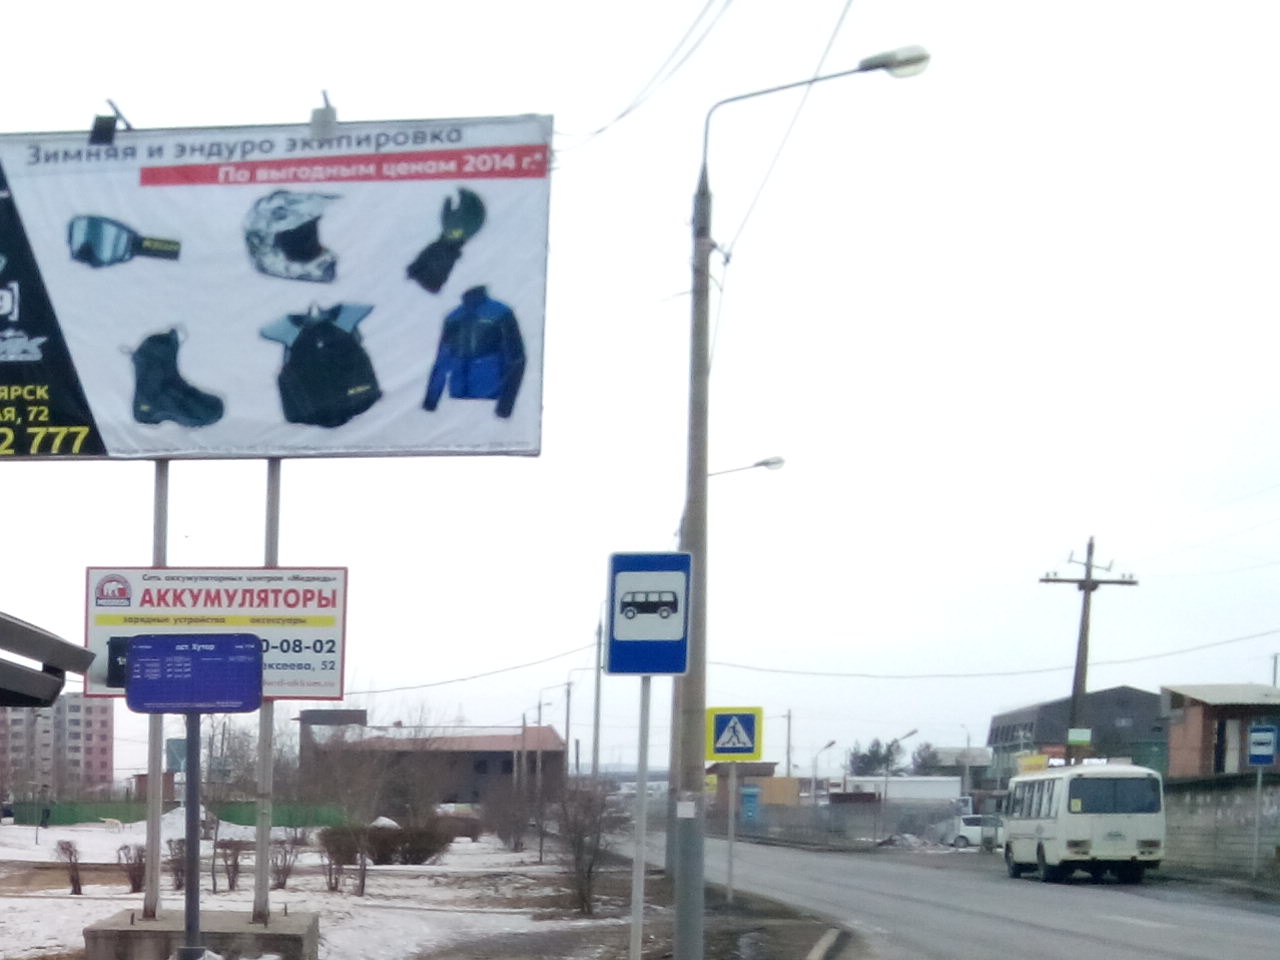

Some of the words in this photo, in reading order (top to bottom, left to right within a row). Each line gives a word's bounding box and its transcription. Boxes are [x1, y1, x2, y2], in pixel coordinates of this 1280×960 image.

[27, 144, 137, 165] Зимняя
[147, 145, 163, 158] и
[174, 139, 275, 161] эндуро
[286, 128, 463, 152] экипировка
[219, 166, 250, 183] По
[256, 163, 377, 182] выгодным
[382, 159, 458, 177] ценам
[463, 154, 516, 172] 2014
[28, 406, 49, 421] 72
[27, 427, 90, 454] 777
[139, 588, 337, 609] АККУМУЛЯТОРЫ
[321, 660, 336, 671] 52
